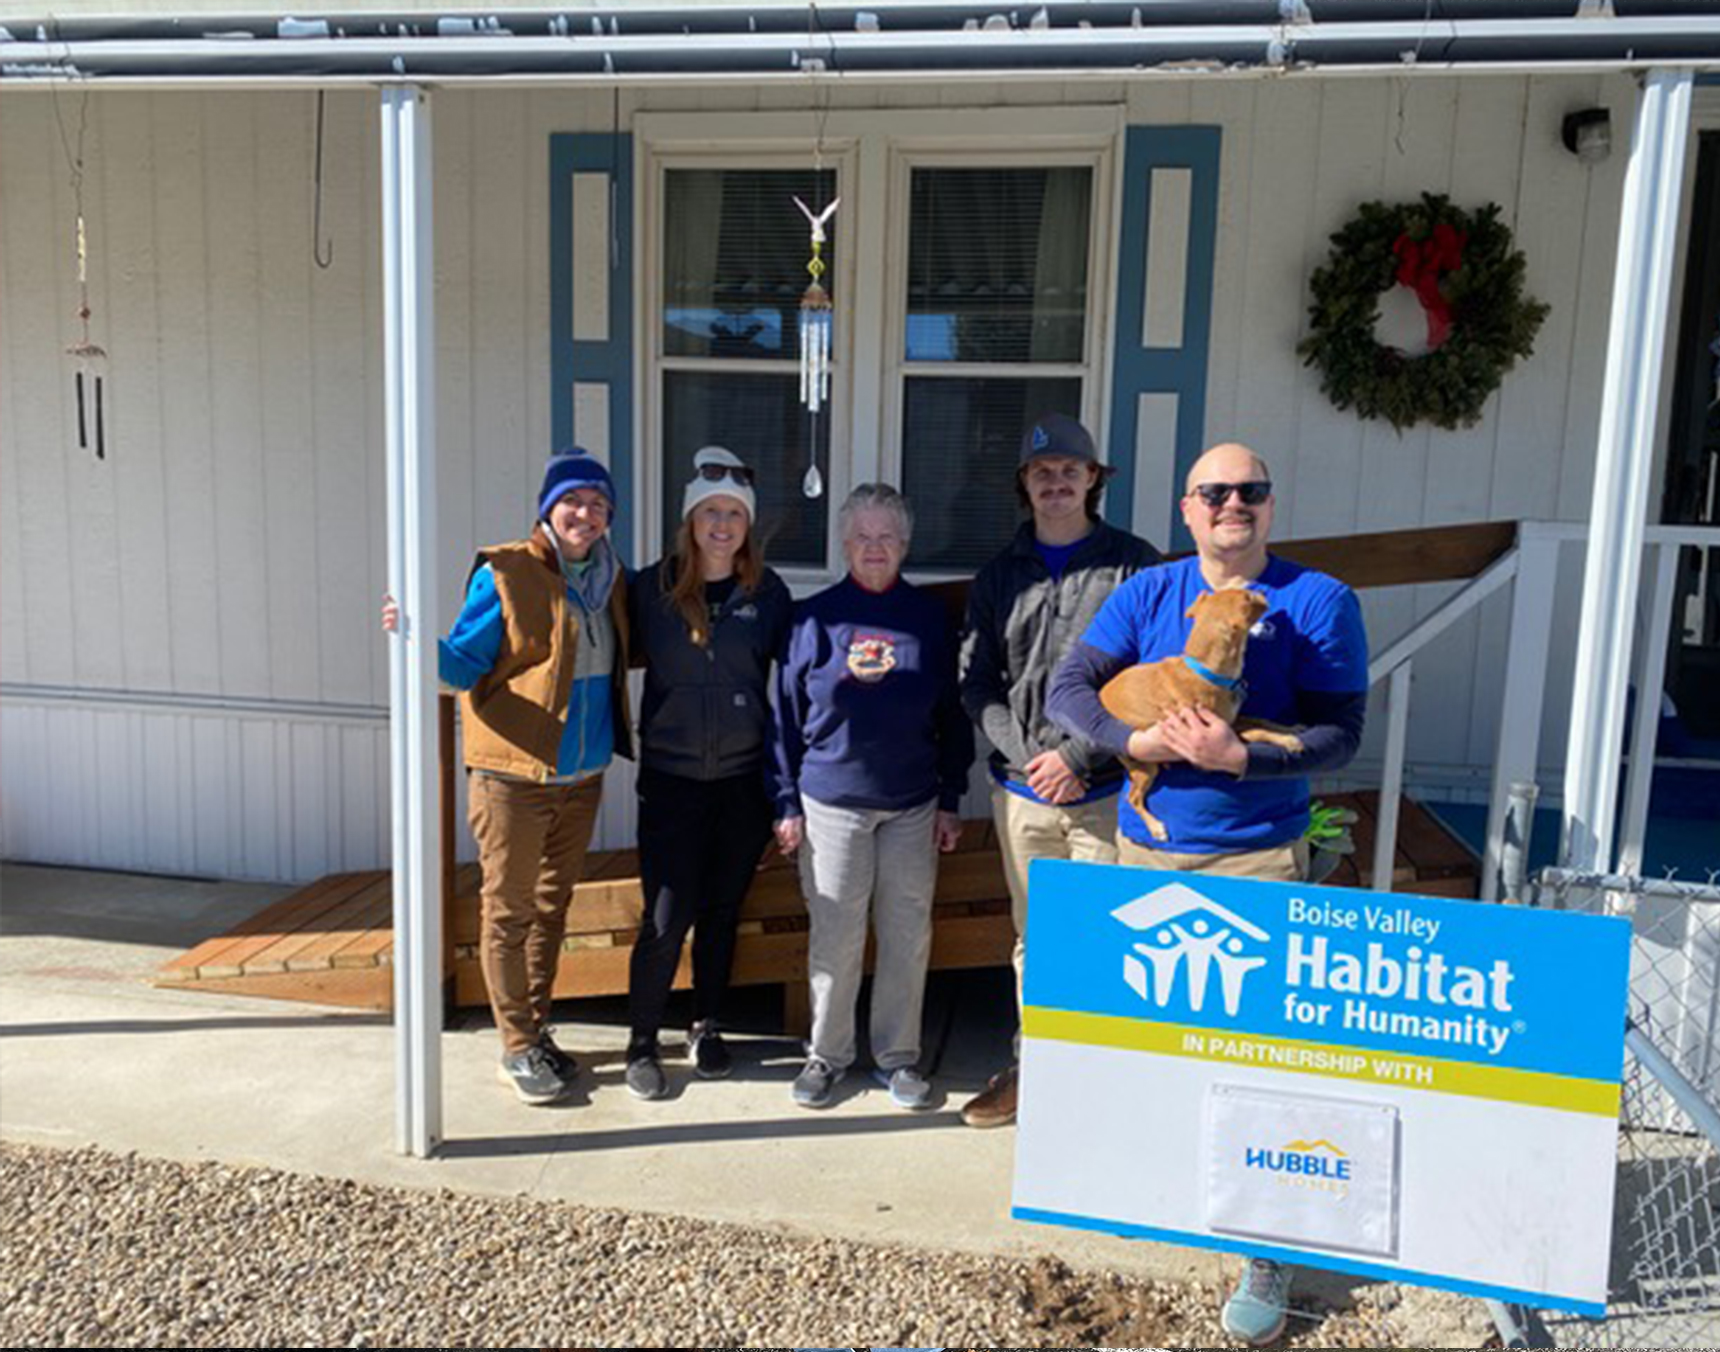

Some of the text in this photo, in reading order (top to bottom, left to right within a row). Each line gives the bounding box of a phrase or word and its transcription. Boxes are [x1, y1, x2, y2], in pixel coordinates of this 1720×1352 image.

[1288, 897, 1441, 944] Boise Valley
[1286, 932, 1515, 1012] Habitat
[1284, 993, 1332, 1026] for
[1182, 1033, 1433, 1085] IN PARTNERSHIP WITH
[1245, 1147, 1352, 1180] HUBBLE
